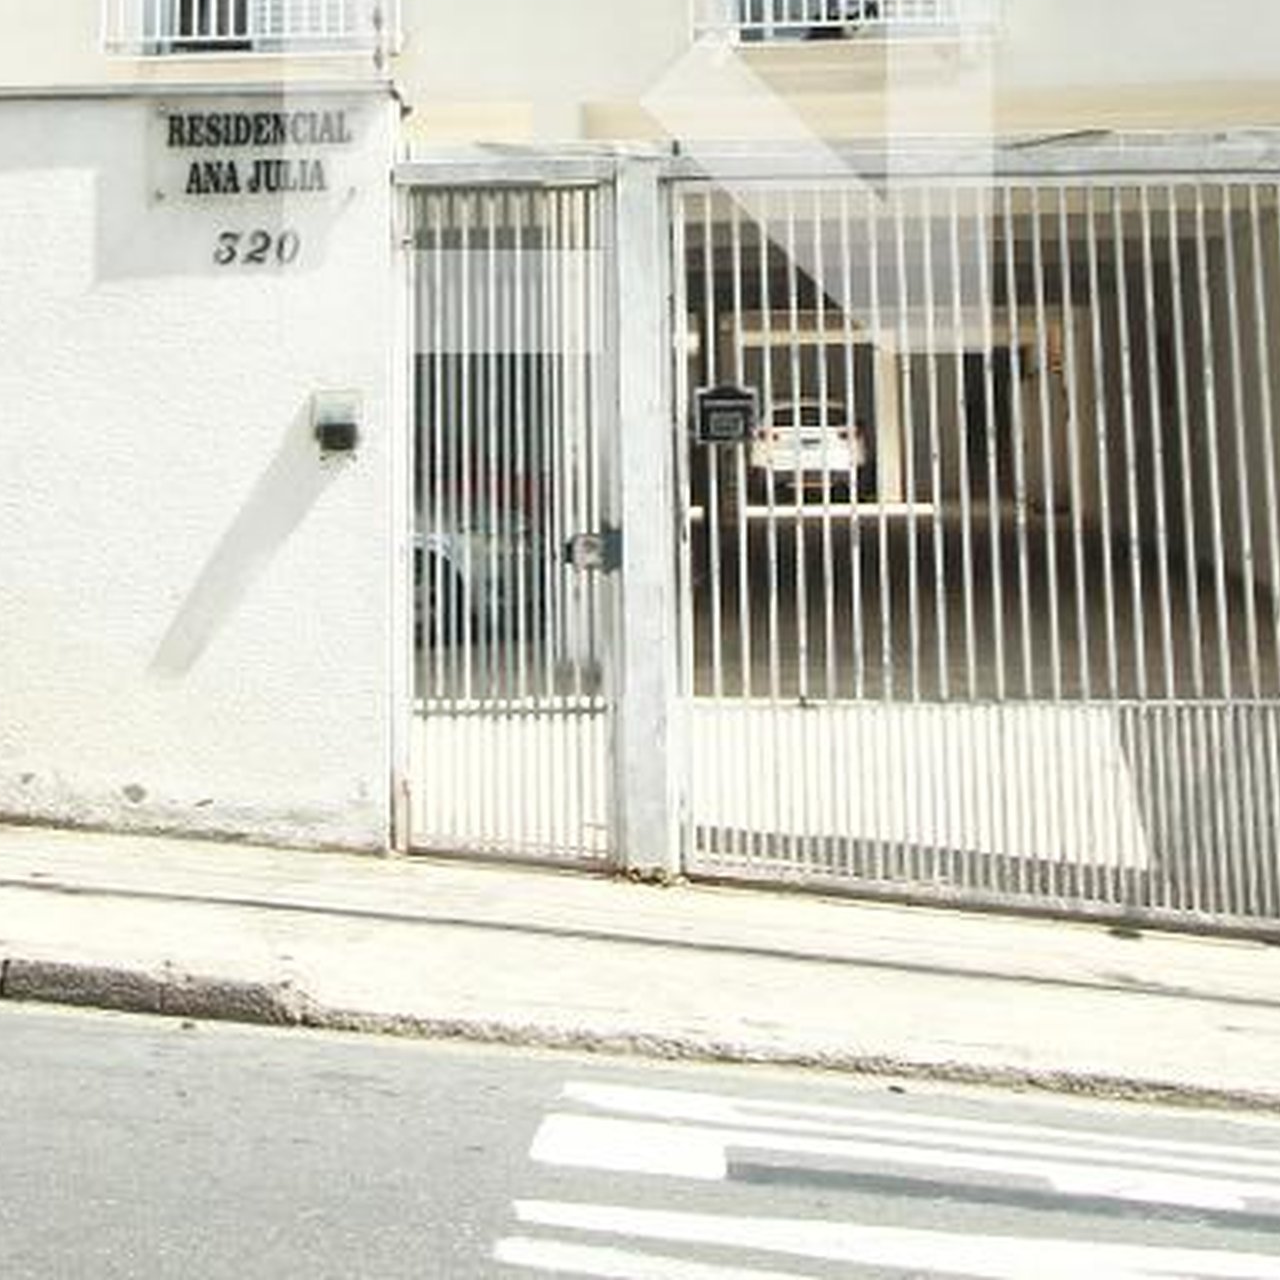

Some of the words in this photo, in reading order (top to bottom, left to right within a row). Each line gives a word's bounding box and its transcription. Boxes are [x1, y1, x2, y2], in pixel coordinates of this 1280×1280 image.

[168, 110, 352, 147] RESIDENCIAL
[186, 161, 241, 194] ANA
[249, 159, 328, 193] JULIA
[213, 230, 301, 265] 320
